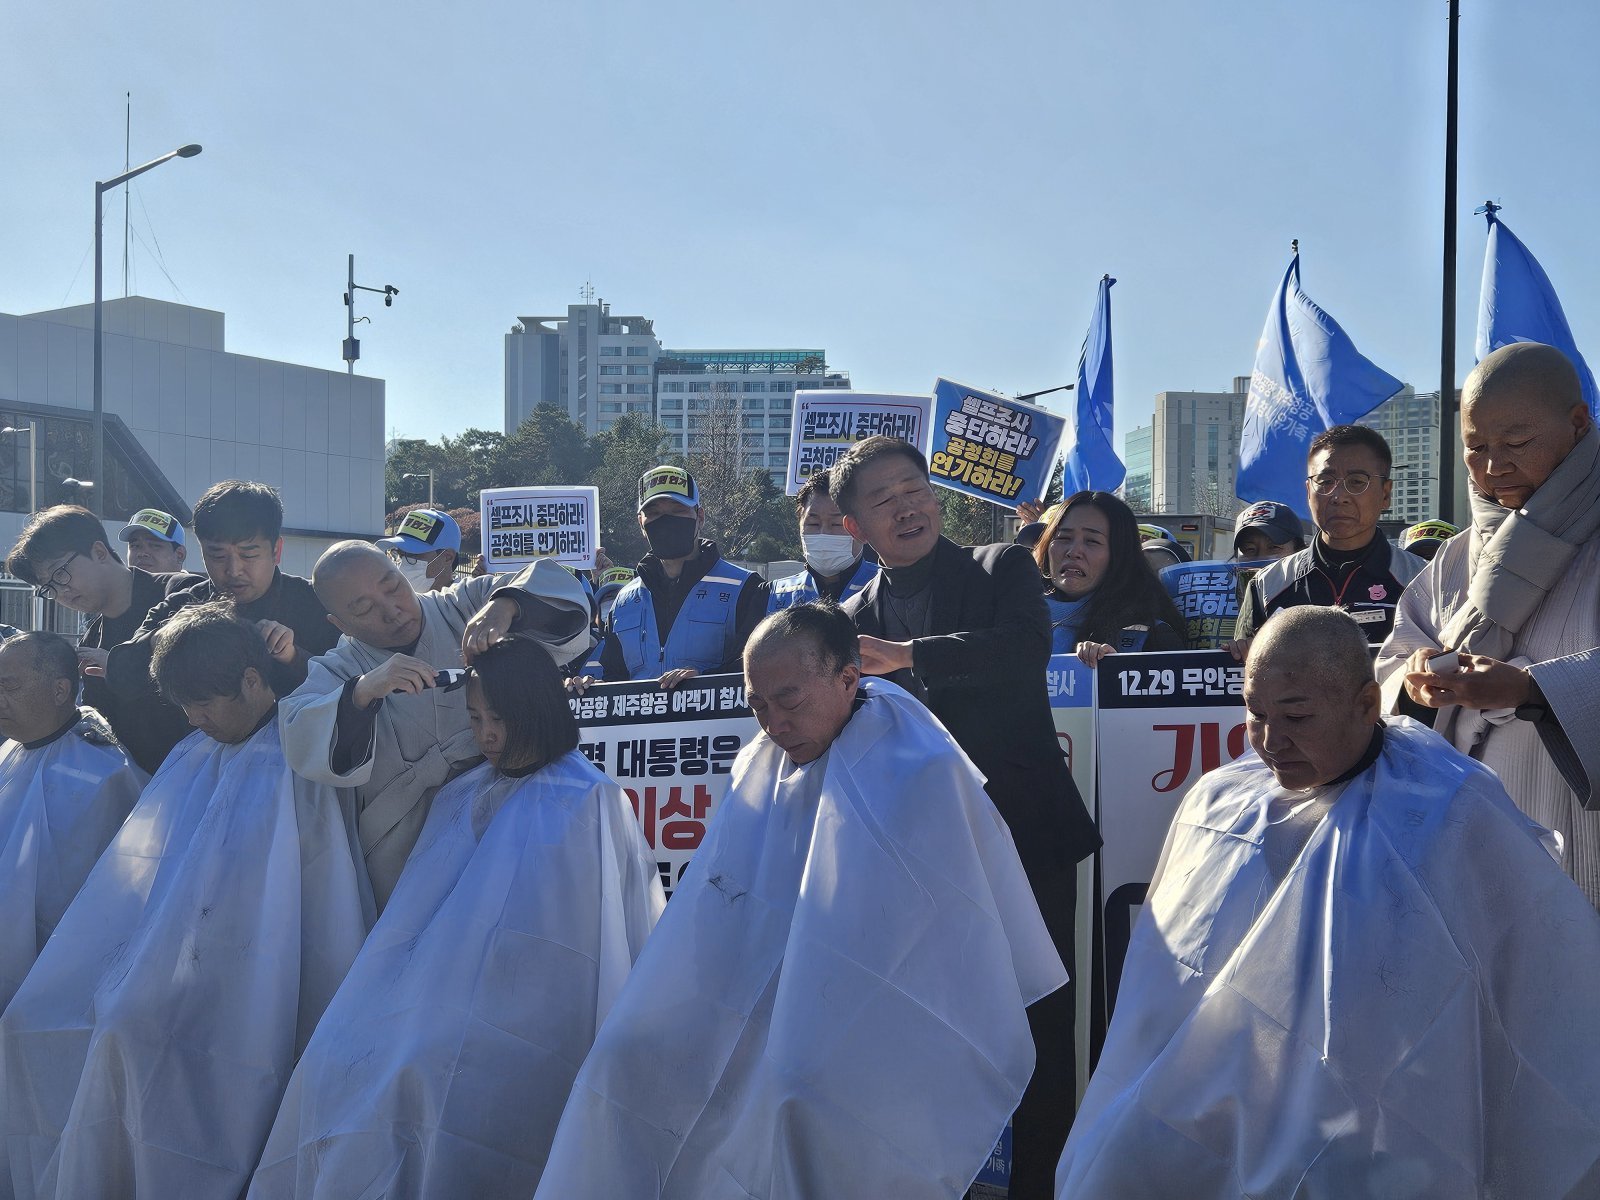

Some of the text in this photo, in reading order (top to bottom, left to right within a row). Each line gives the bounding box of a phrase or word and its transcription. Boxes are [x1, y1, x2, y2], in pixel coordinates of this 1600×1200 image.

[804, 412, 916, 442] 셀프조사 중단하라!
[962, 396, 1030, 432] 셀프조사
[945, 410, 1037, 456] 중단하라!
[947, 436, 1016, 472] 공청회를
[930, 452, 1023, 496] 연기하라!
[491, 502, 584, 530] 셀프조사 중단하라!
[491, 530, 586, 558] 공청회를 연기하라!
[1118, 670, 1176, 696] 12.29
[612, 692, 668, 717] 제주항공
[672, 688, 715, 713] 여객기
[616, 735, 740, 778] 대통령은
